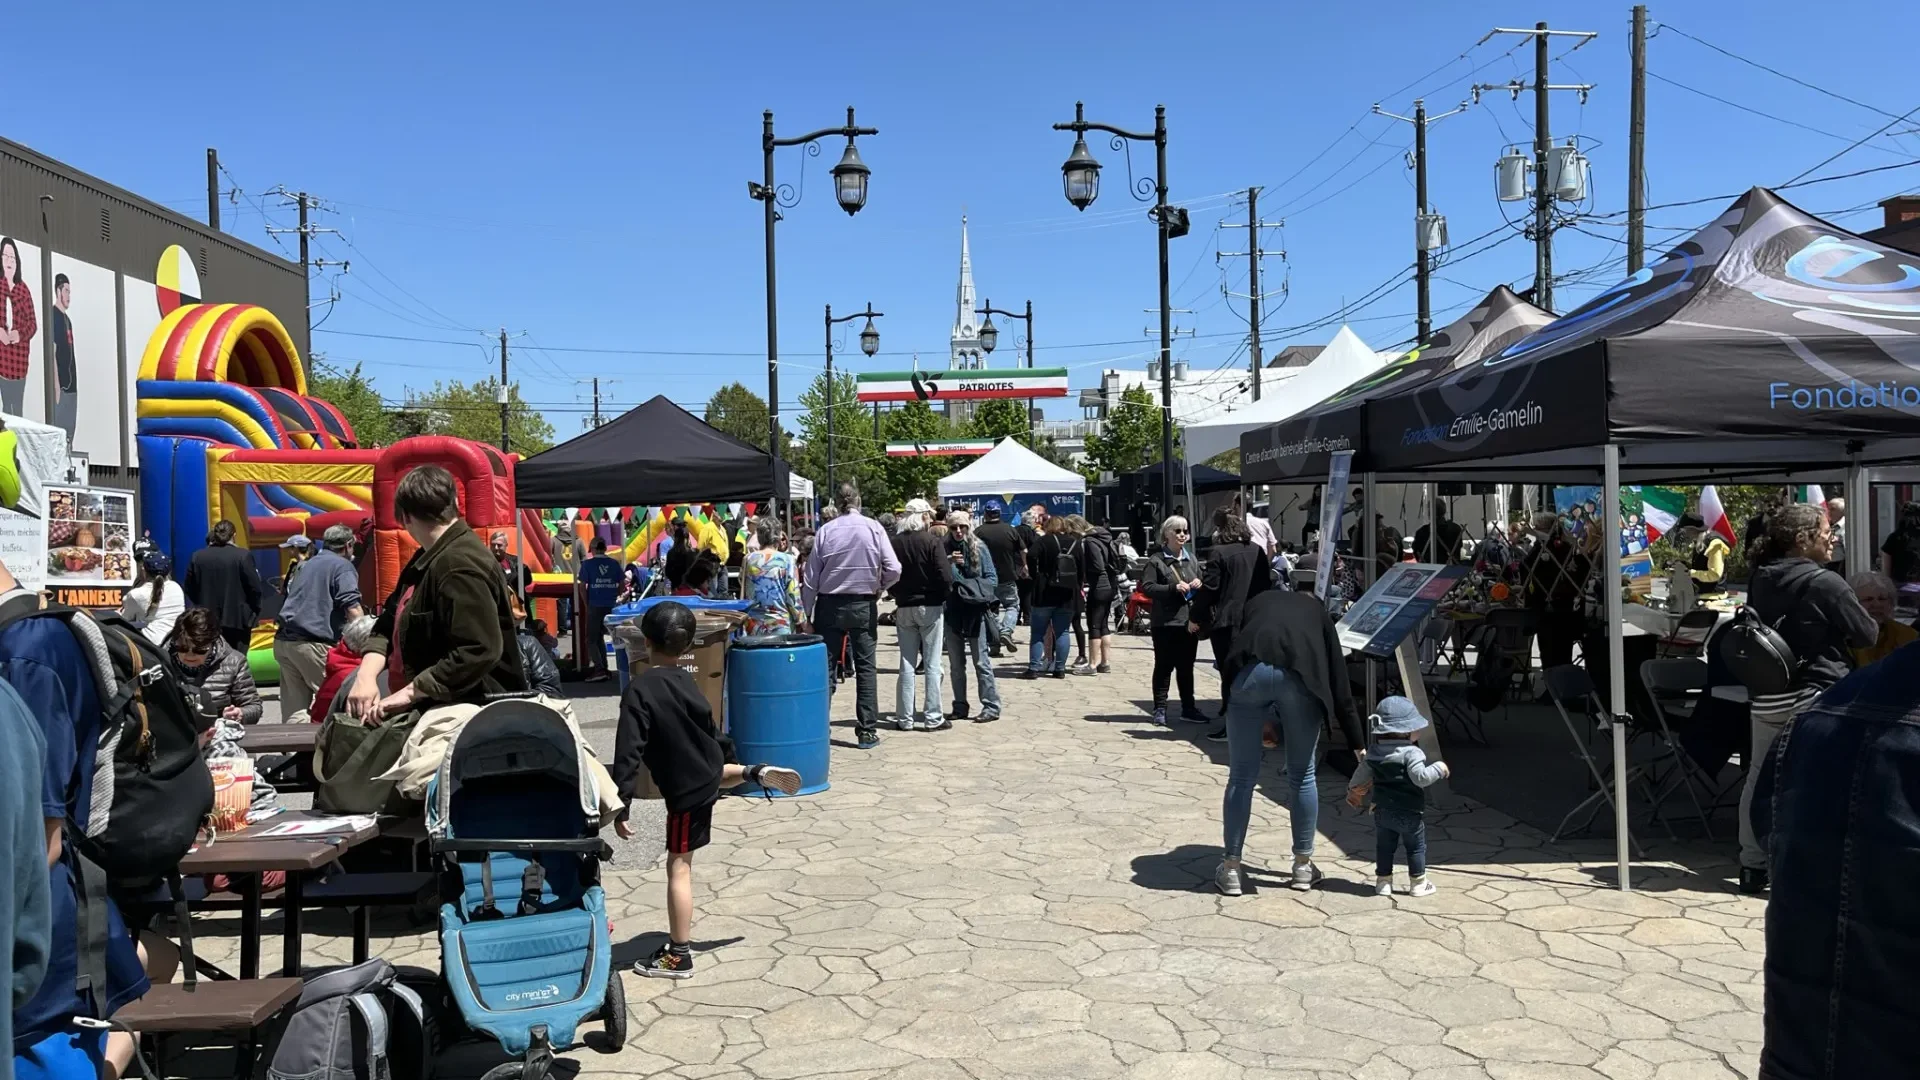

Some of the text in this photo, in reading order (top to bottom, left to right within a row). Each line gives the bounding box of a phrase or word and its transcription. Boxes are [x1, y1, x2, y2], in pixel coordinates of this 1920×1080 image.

[959, 382, 1014, 392] PATRIOTES
[1769, 380, 1920, 409] Fondatio
[1401, 401, 1543, 445] Fondation Émilie-Gamelin
[1304, 434, 1351, 454] Émilie-Gamelin
[58, 589, 122, 606] L'ANNEXE
[505, 993, 520, 1001] city
[521, 990, 540, 999] mini
